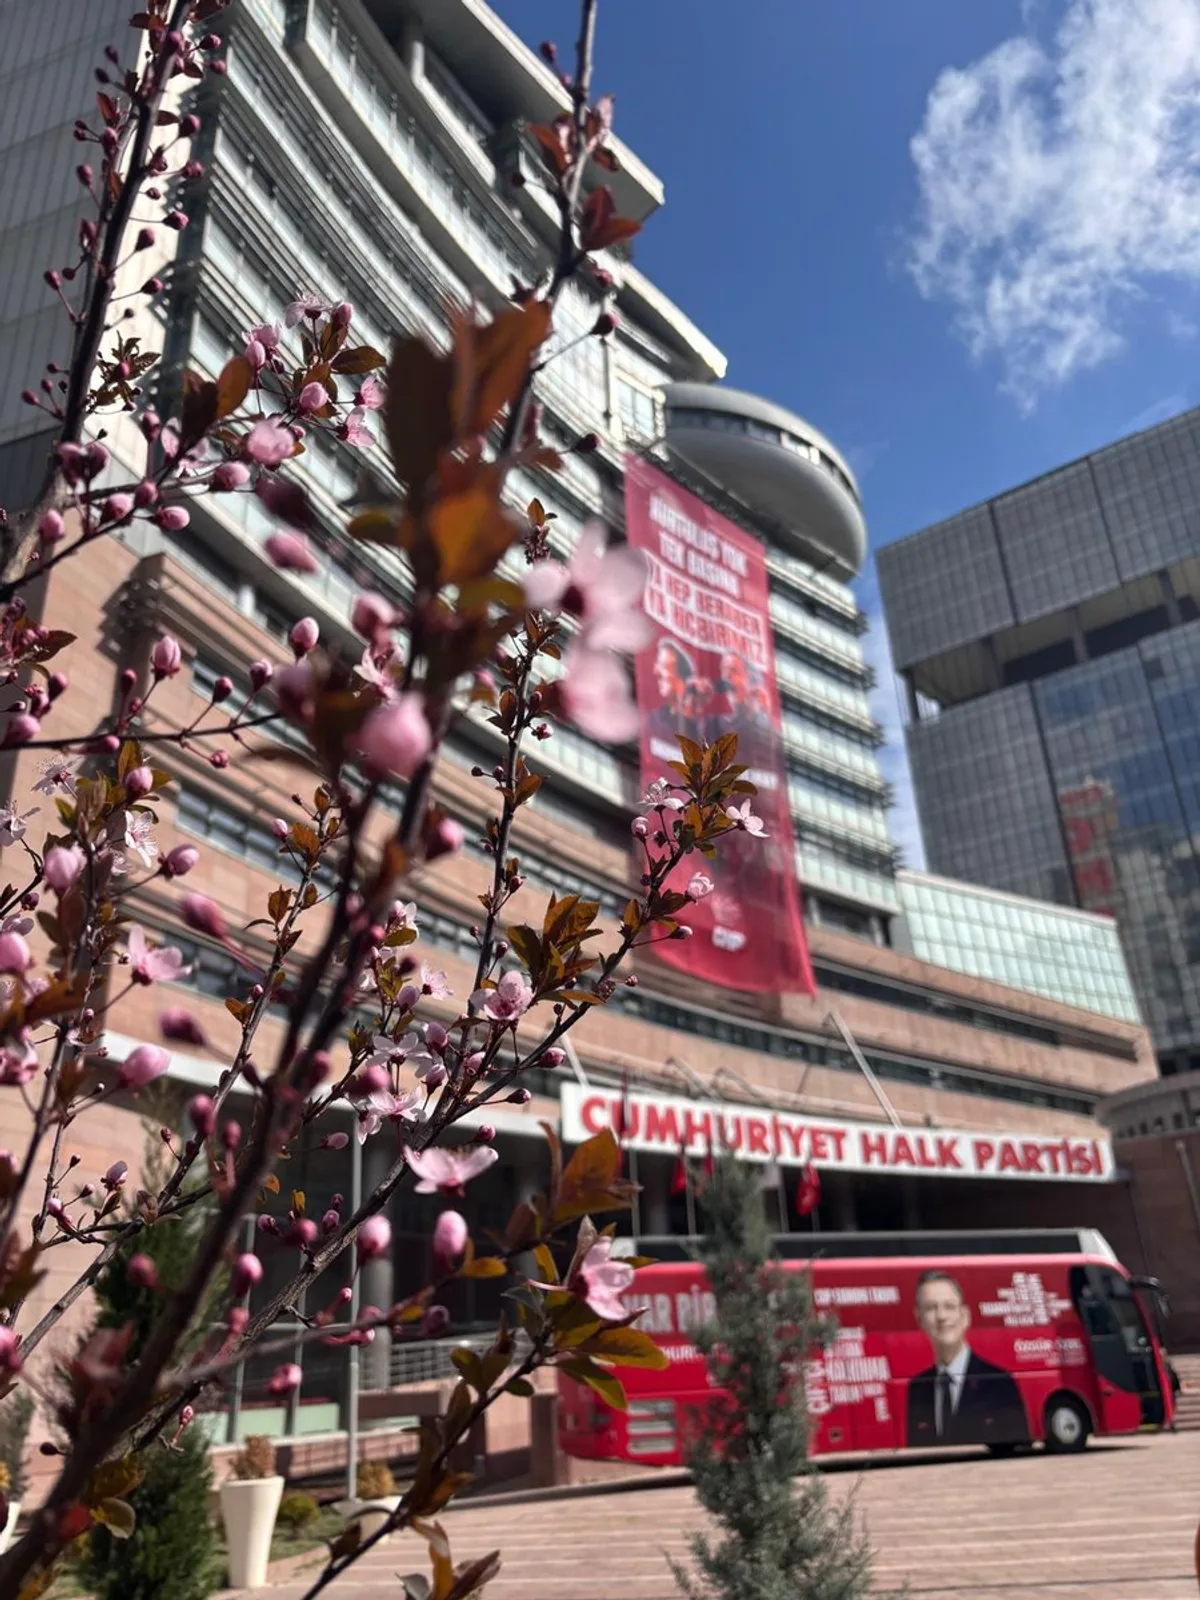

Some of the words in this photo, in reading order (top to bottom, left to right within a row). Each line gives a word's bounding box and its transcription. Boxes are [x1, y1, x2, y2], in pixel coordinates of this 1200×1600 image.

[580, 1097, 846, 1162] CUMHURİYET
[860, 1130, 962, 1169] HALK
[972, 1137, 1104, 1176] PARTİSİ
